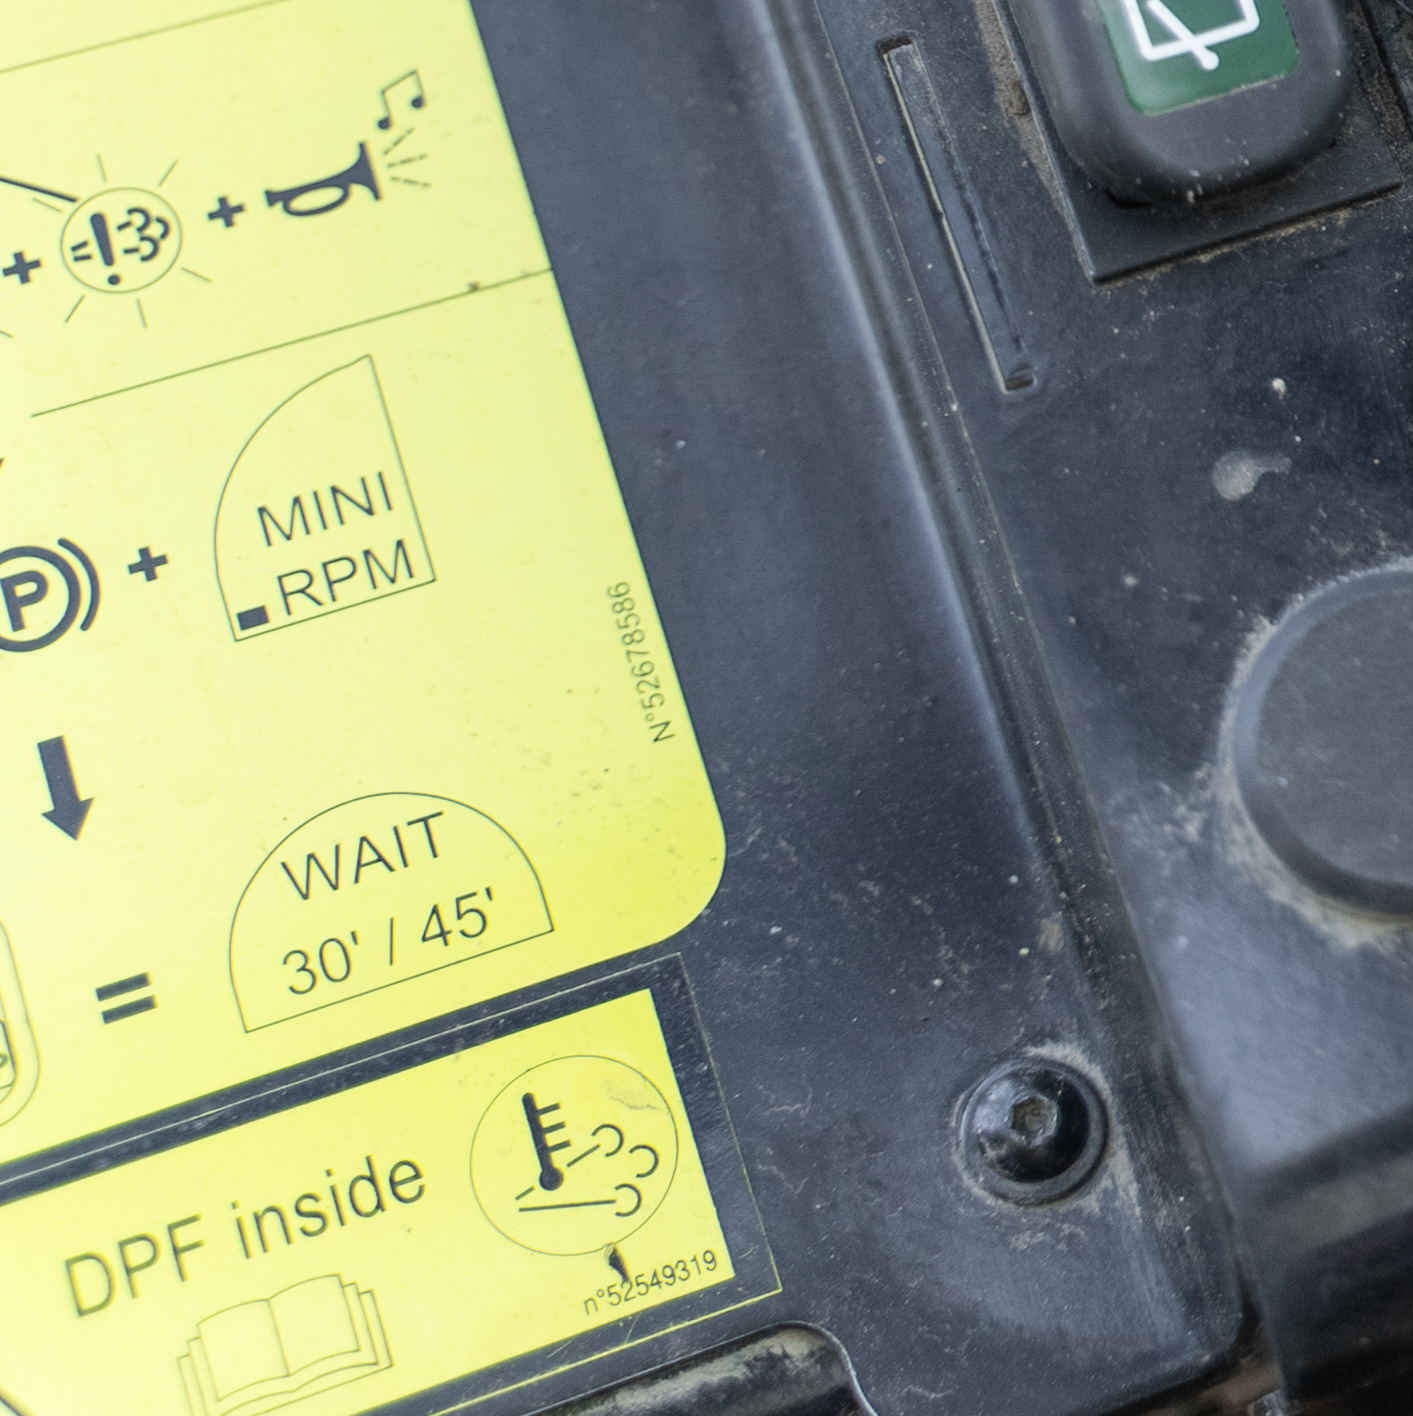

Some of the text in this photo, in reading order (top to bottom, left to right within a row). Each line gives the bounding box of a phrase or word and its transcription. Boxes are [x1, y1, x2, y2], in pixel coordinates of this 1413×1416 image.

[257, 471, 393, 547] MINI
[277, 538, 415, 616] RPM
[606, 581, 677, 743] N°52678586
[280, 810, 445, 901] WAIT
[282, 930, 360, 995] 30'
[421, 886, 495, 947] 45'
[65, 1154, 427, 1318] DPF inside
[583, 1249, 718, 1315] n°52549319
